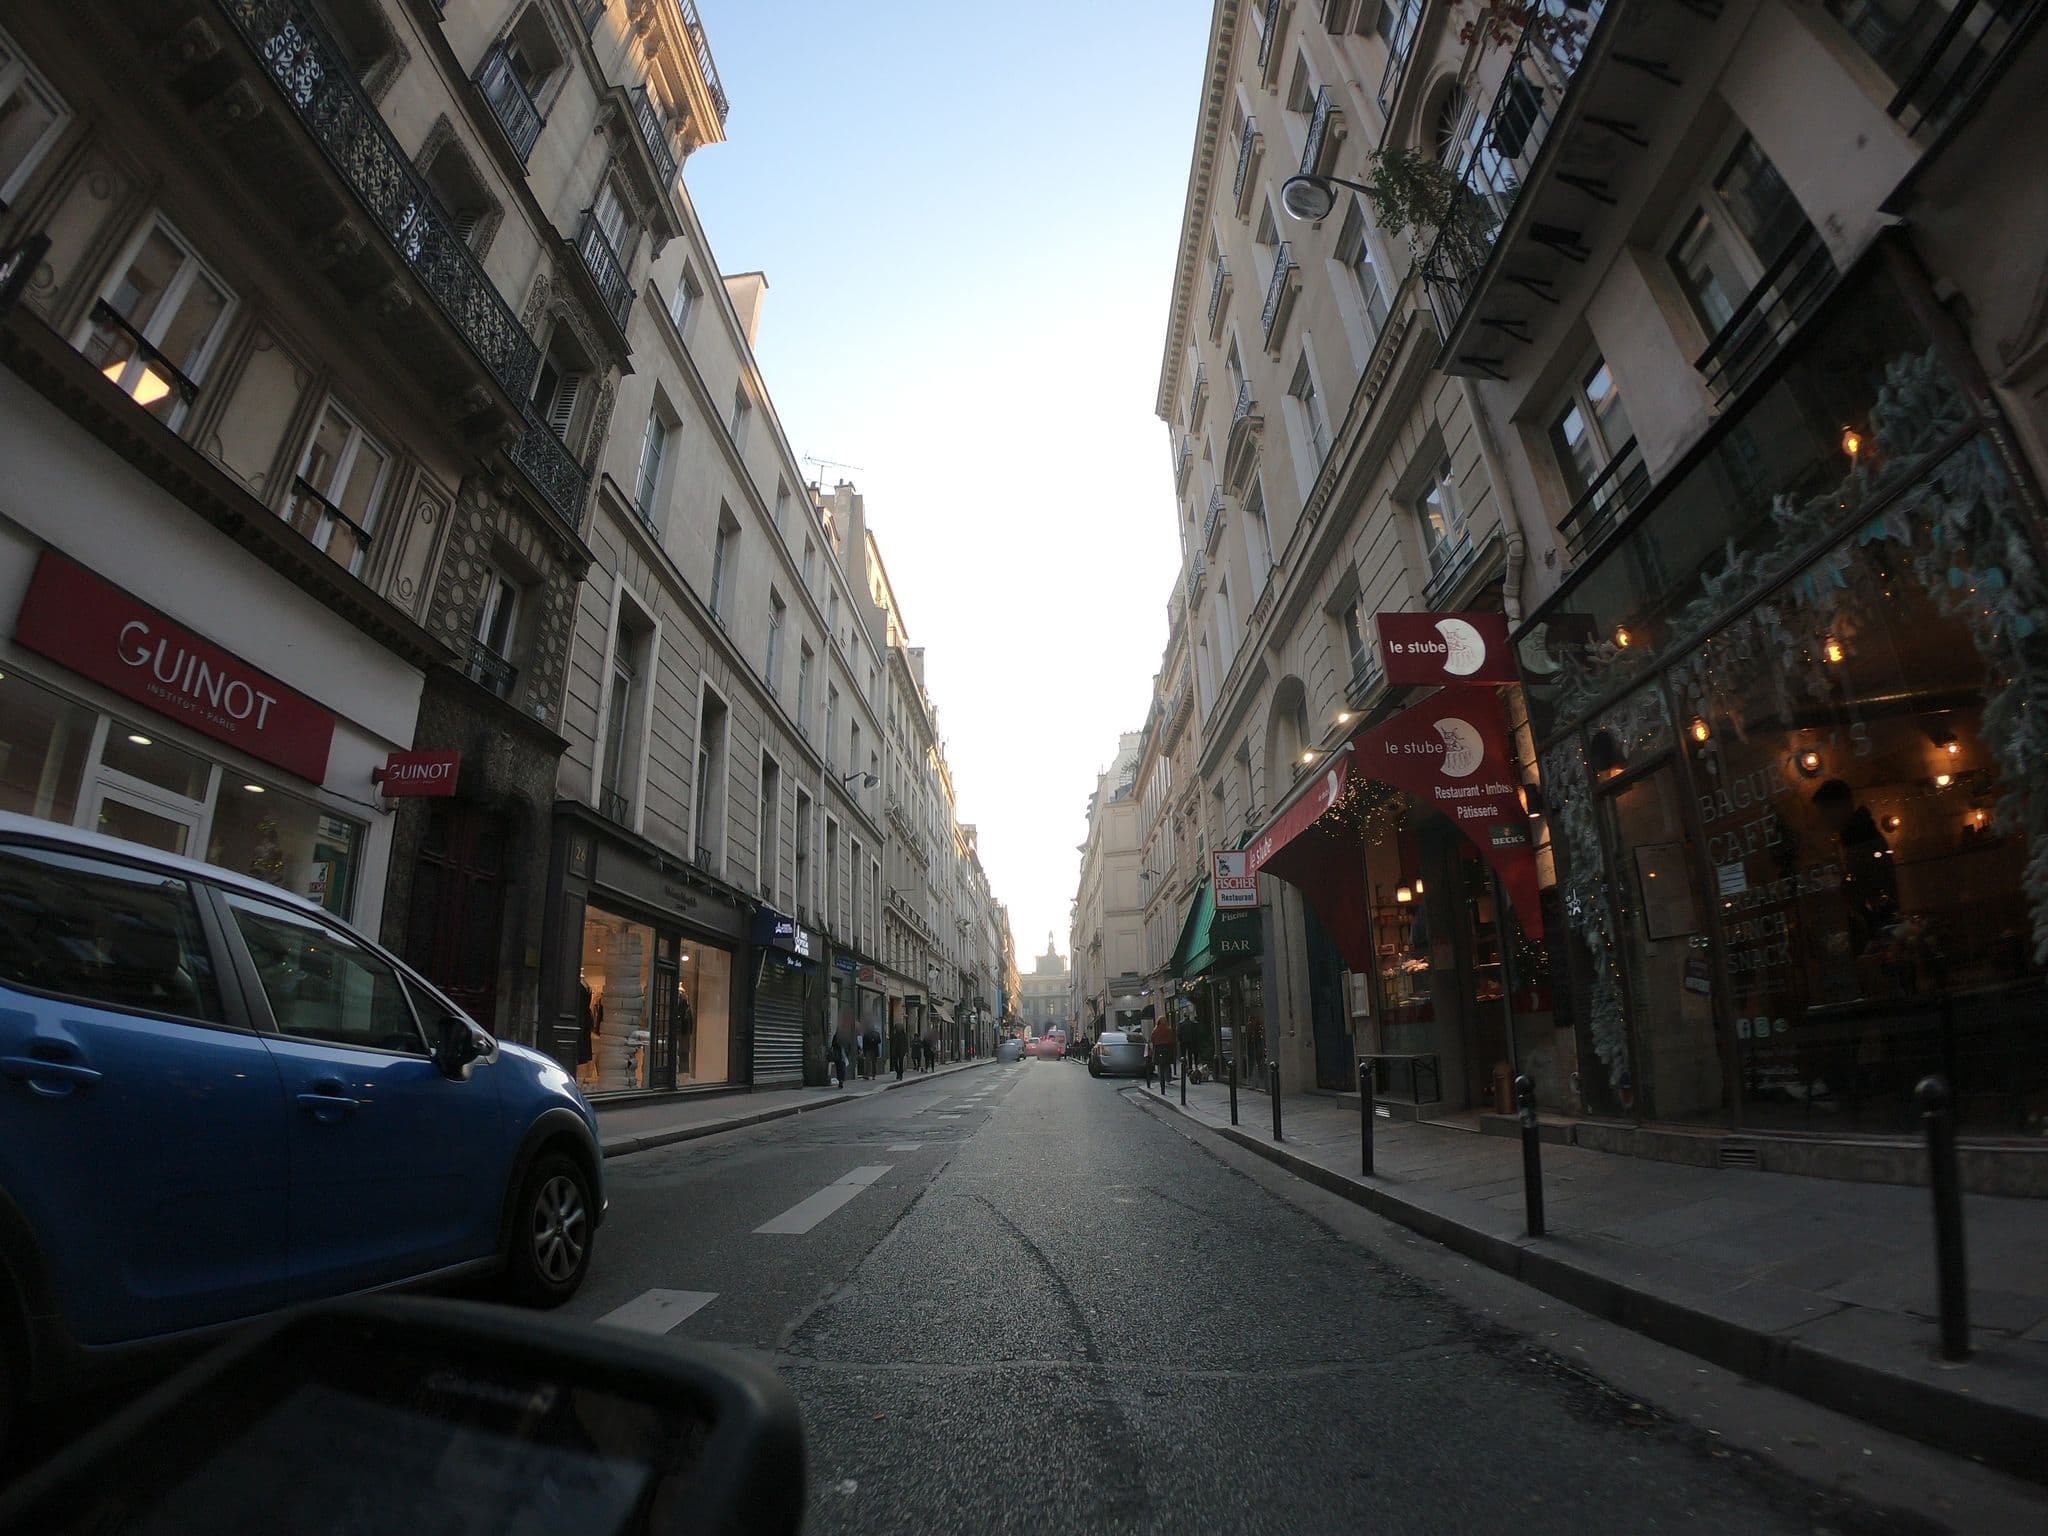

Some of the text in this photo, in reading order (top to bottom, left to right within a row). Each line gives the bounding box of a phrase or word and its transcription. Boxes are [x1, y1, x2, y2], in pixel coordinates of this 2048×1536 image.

[1389, 640, 1447, 654] le stube
[117, 621, 277, 731] GUINOT
[146, 682, 237, 732] INSTITUT PARIS
[1385, 740, 1444, 754] le stube
[390, 763, 454, 780] GUINOT
[1434, 785, 1480, 799] Restaurant
[1457, 804, 1499, 819] Pâtisserie
[1492, 835, 1525, 845] BECK'S
[1709, 805, 1784, 867] CAFÉ
[575, 846, 587, 861] 26
[1216, 878, 1257, 890] FISCHER
[1221, 893, 1254, 902] Restaurant
[1222, 940, 1250, 951] BAR
